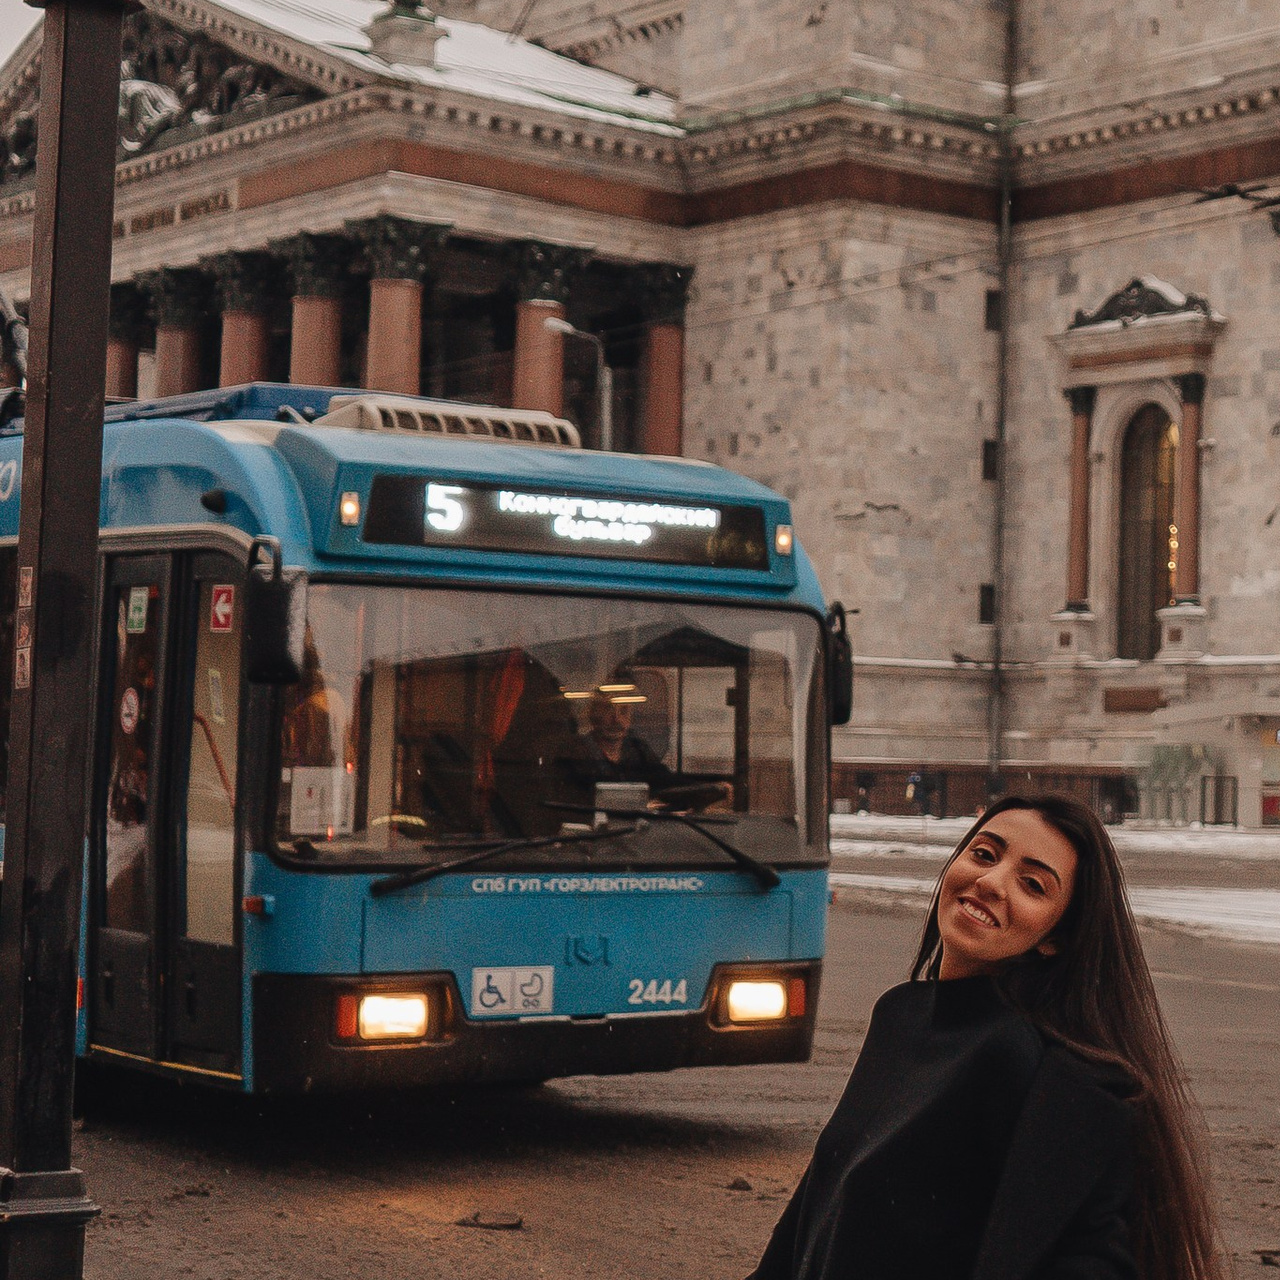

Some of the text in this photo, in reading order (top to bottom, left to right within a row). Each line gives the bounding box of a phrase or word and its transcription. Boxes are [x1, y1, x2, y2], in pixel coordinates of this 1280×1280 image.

[426, 482, 465, 531] 5
[508, 877, 541, 893] ГУП
[627, 978, 688, 1005] 2444
